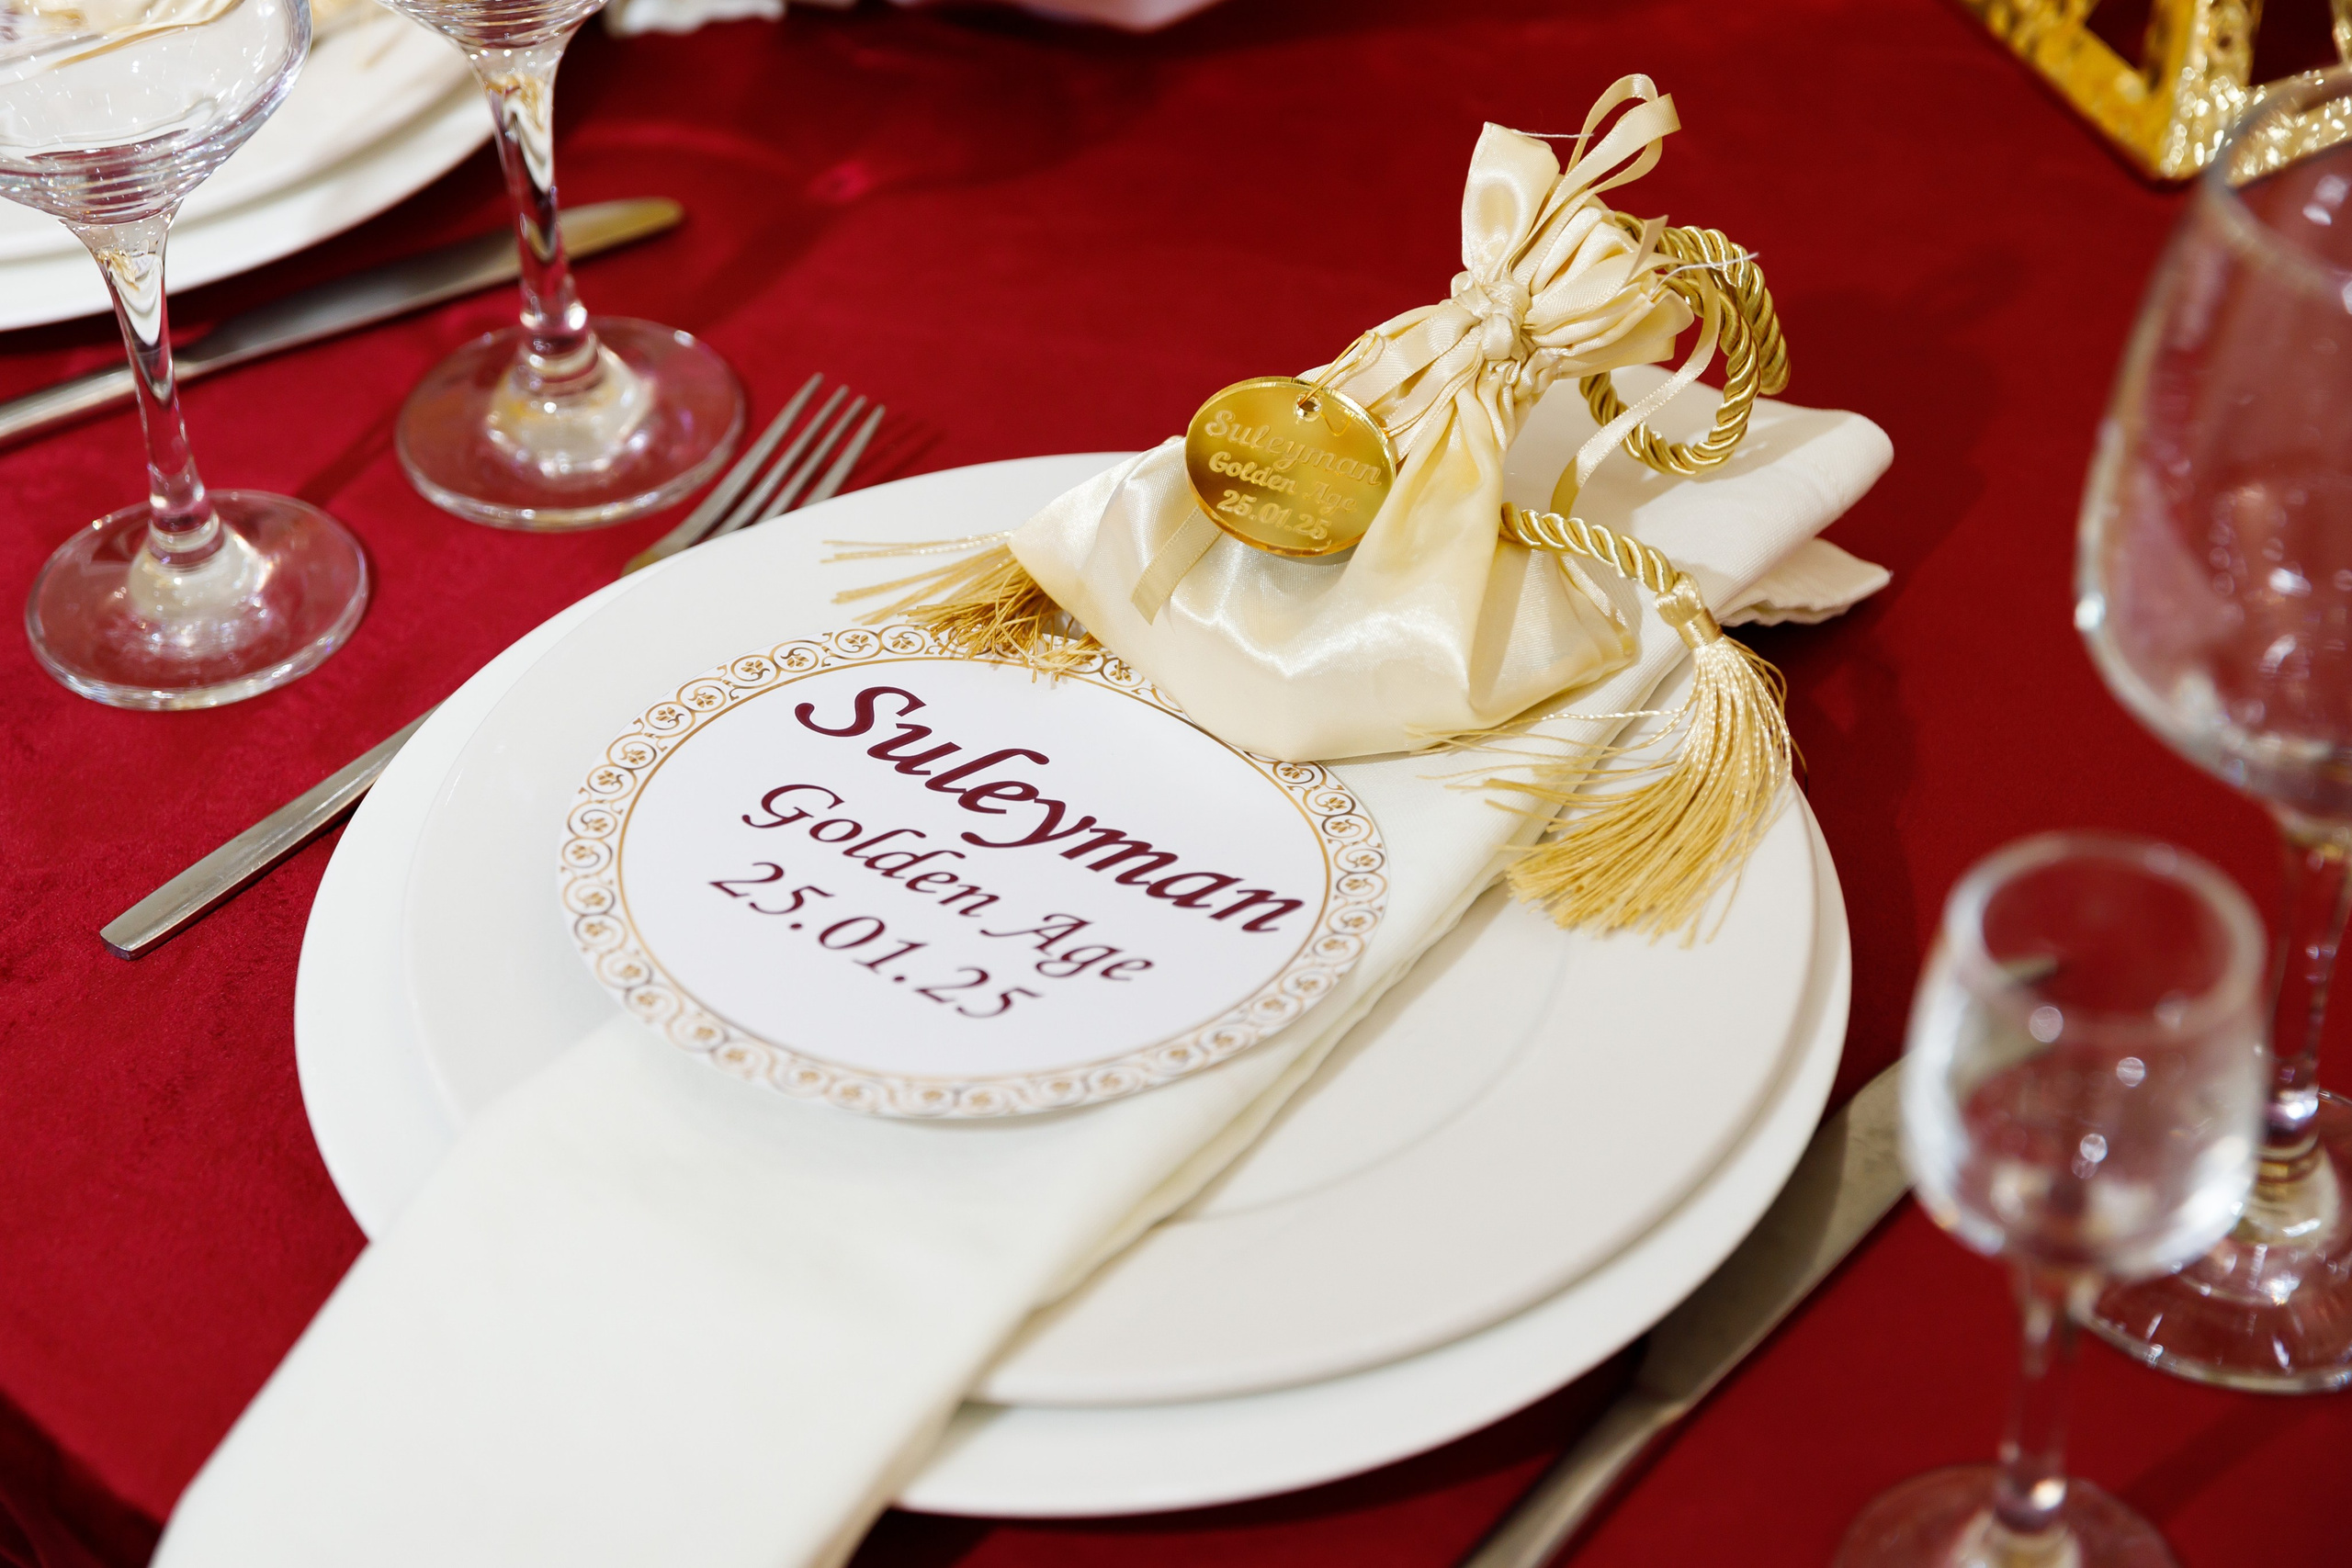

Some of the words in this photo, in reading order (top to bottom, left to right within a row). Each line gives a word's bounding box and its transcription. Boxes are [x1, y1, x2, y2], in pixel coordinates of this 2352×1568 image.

[1204, 410, 1382, 486] Suleyman
[1208, 451, 1298, 495] Golden
[1302, 480, 1358, 514] Age
[1216, 489, 1332, 540] 25.01.25
[794, 685, 1305, 933] Suleyman
[708, 862, 1041, 1019] 25.01.25
[741, 784, 1001, 917] Golden
[979, 913, 1154, 982] Age
